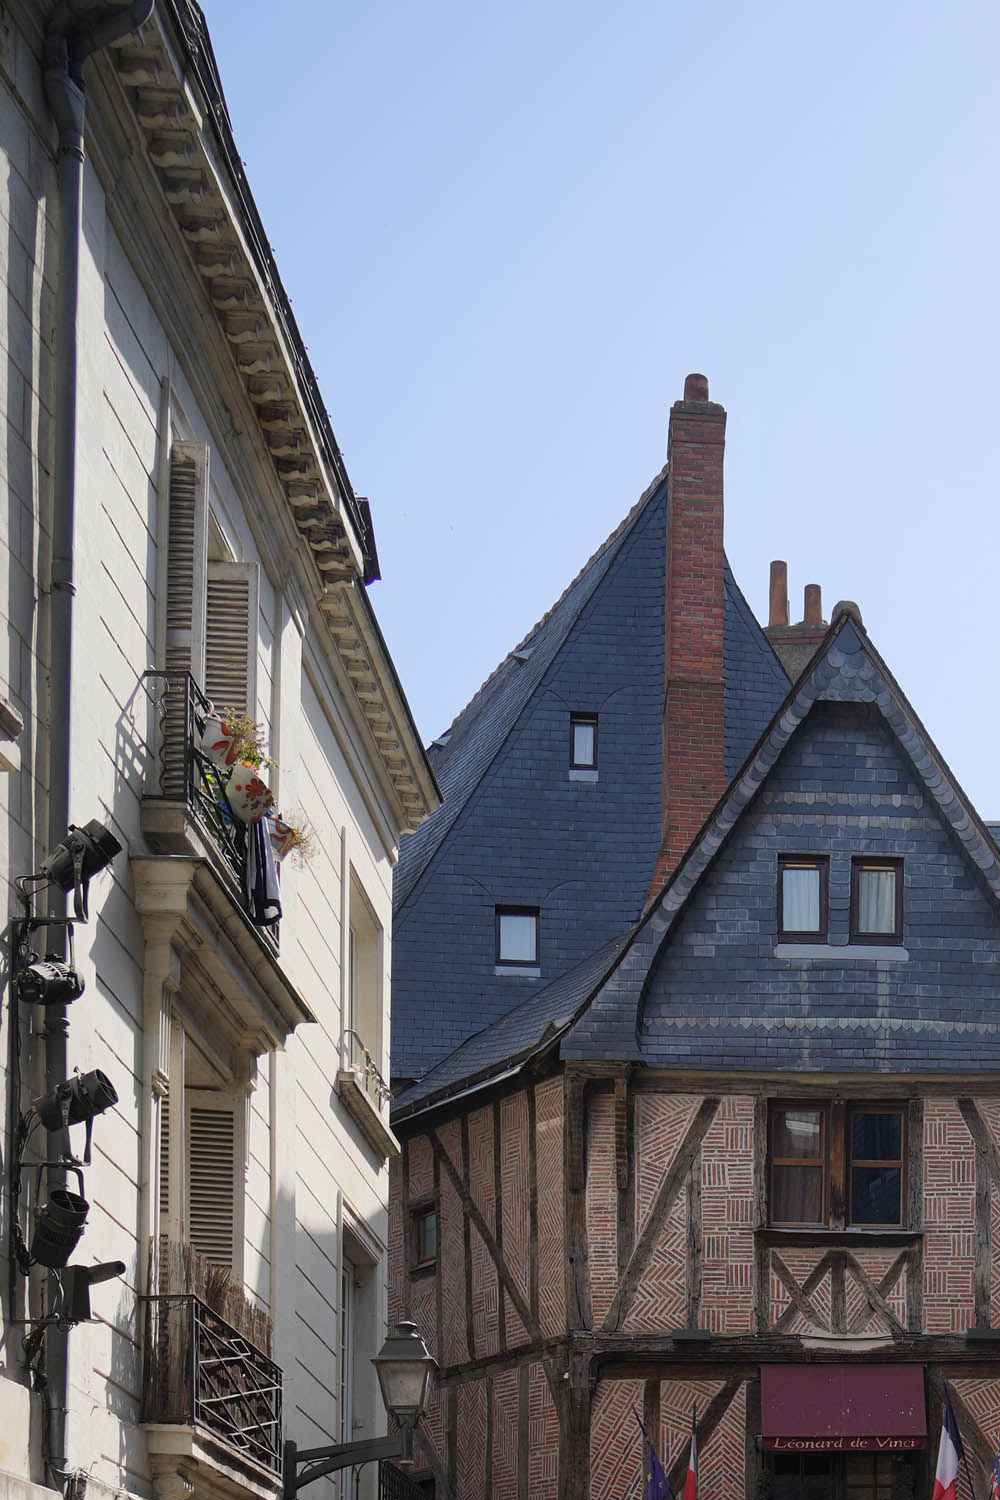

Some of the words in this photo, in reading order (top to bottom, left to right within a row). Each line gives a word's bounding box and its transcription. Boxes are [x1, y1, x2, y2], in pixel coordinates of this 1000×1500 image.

[774, 1437, 844, 1449] Léonard
[850, 1437, 869, 1448] de
[876, 1437, 916, 1448] Vinci
